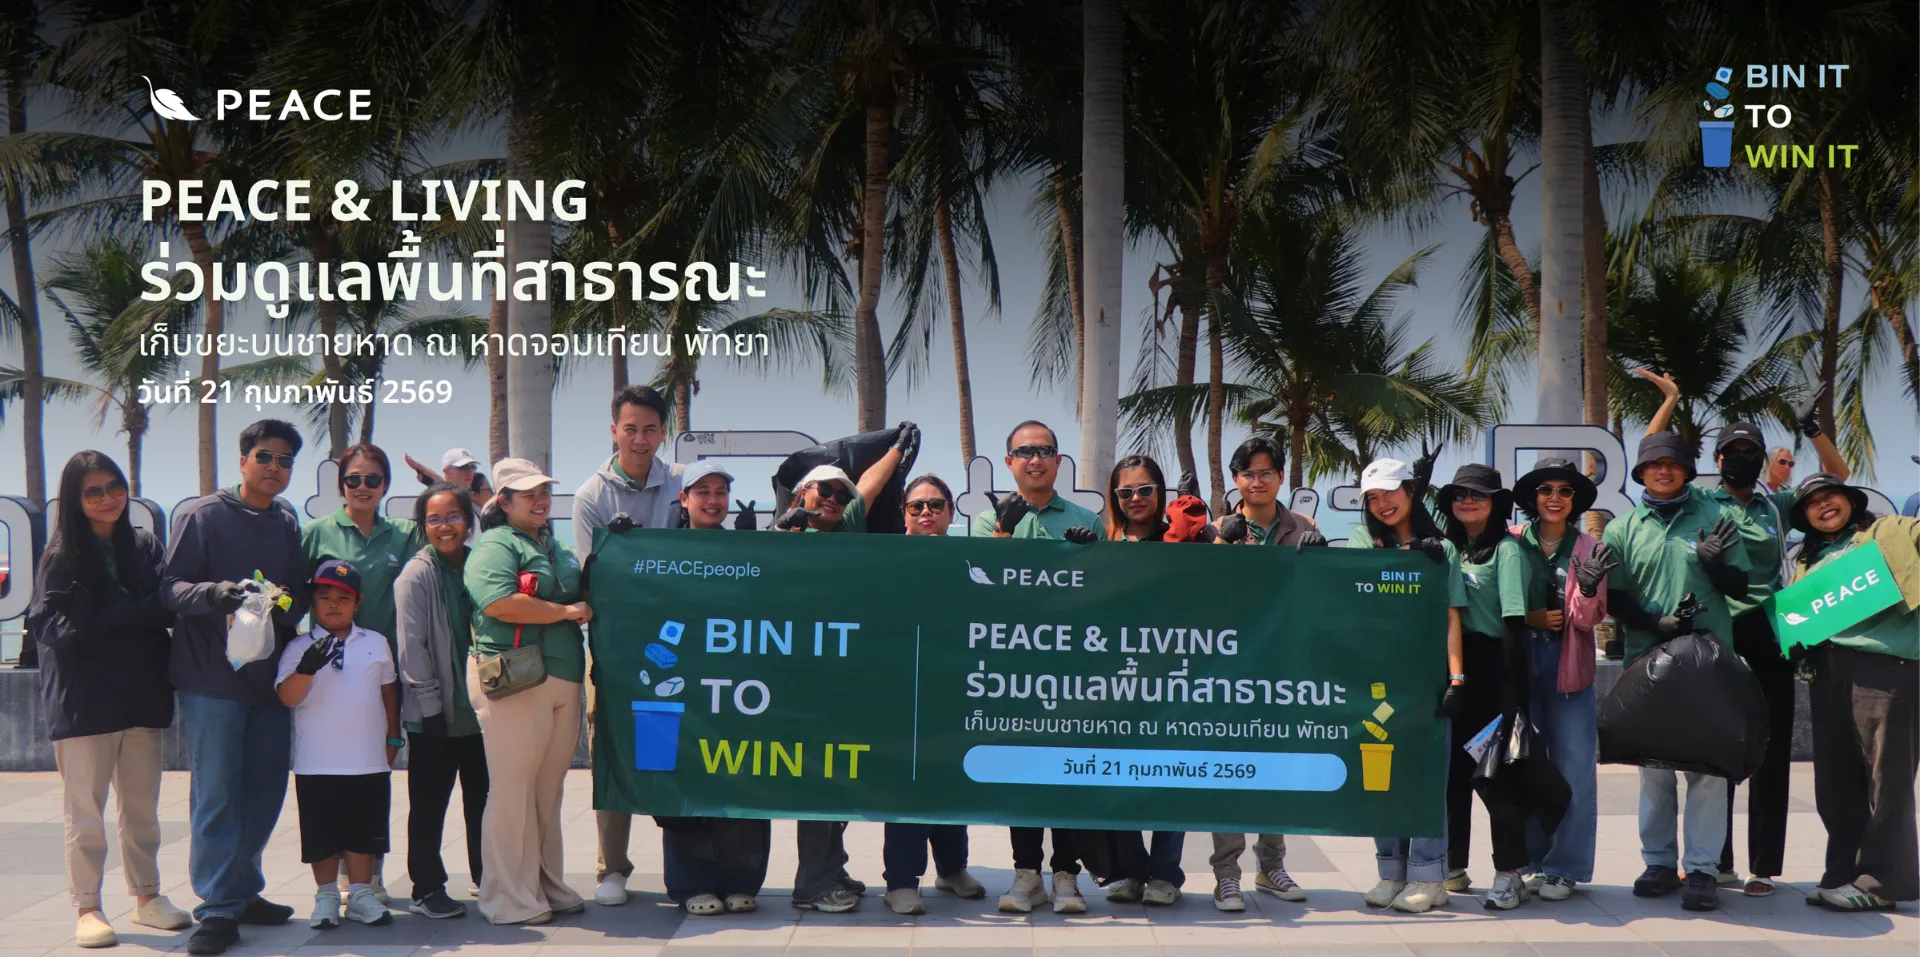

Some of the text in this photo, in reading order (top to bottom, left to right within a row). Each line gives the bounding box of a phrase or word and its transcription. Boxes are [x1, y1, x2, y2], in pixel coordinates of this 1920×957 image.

[633, 560, 761, 579] #PEACEpeople
[1003, 568, 1084, 587] PEACE
[1381, 571, 1421, 581] BIN IT
[1355, 582, 1421, 594] TO WIN IT
[1810, 569, 1880, 614] PEACE
[706, 618, 860, 657] BIN IT
[968, 622, 1238, 655] PEACE & LIVING
[700, 678, 771, 715] TO
[966, 657, 1346, 710] ร่วมดูแลพื้นที่สาธารณะ
[964, 709, 1348, 740] เก็บขยะบนชายหาด ณ หาดจอมเทียน พัทยา
[699, 739, 870, 779] WIN IT
[1063, 754, 1256, 780] วันที่ 21 กุมภาพันธ์ 2569
